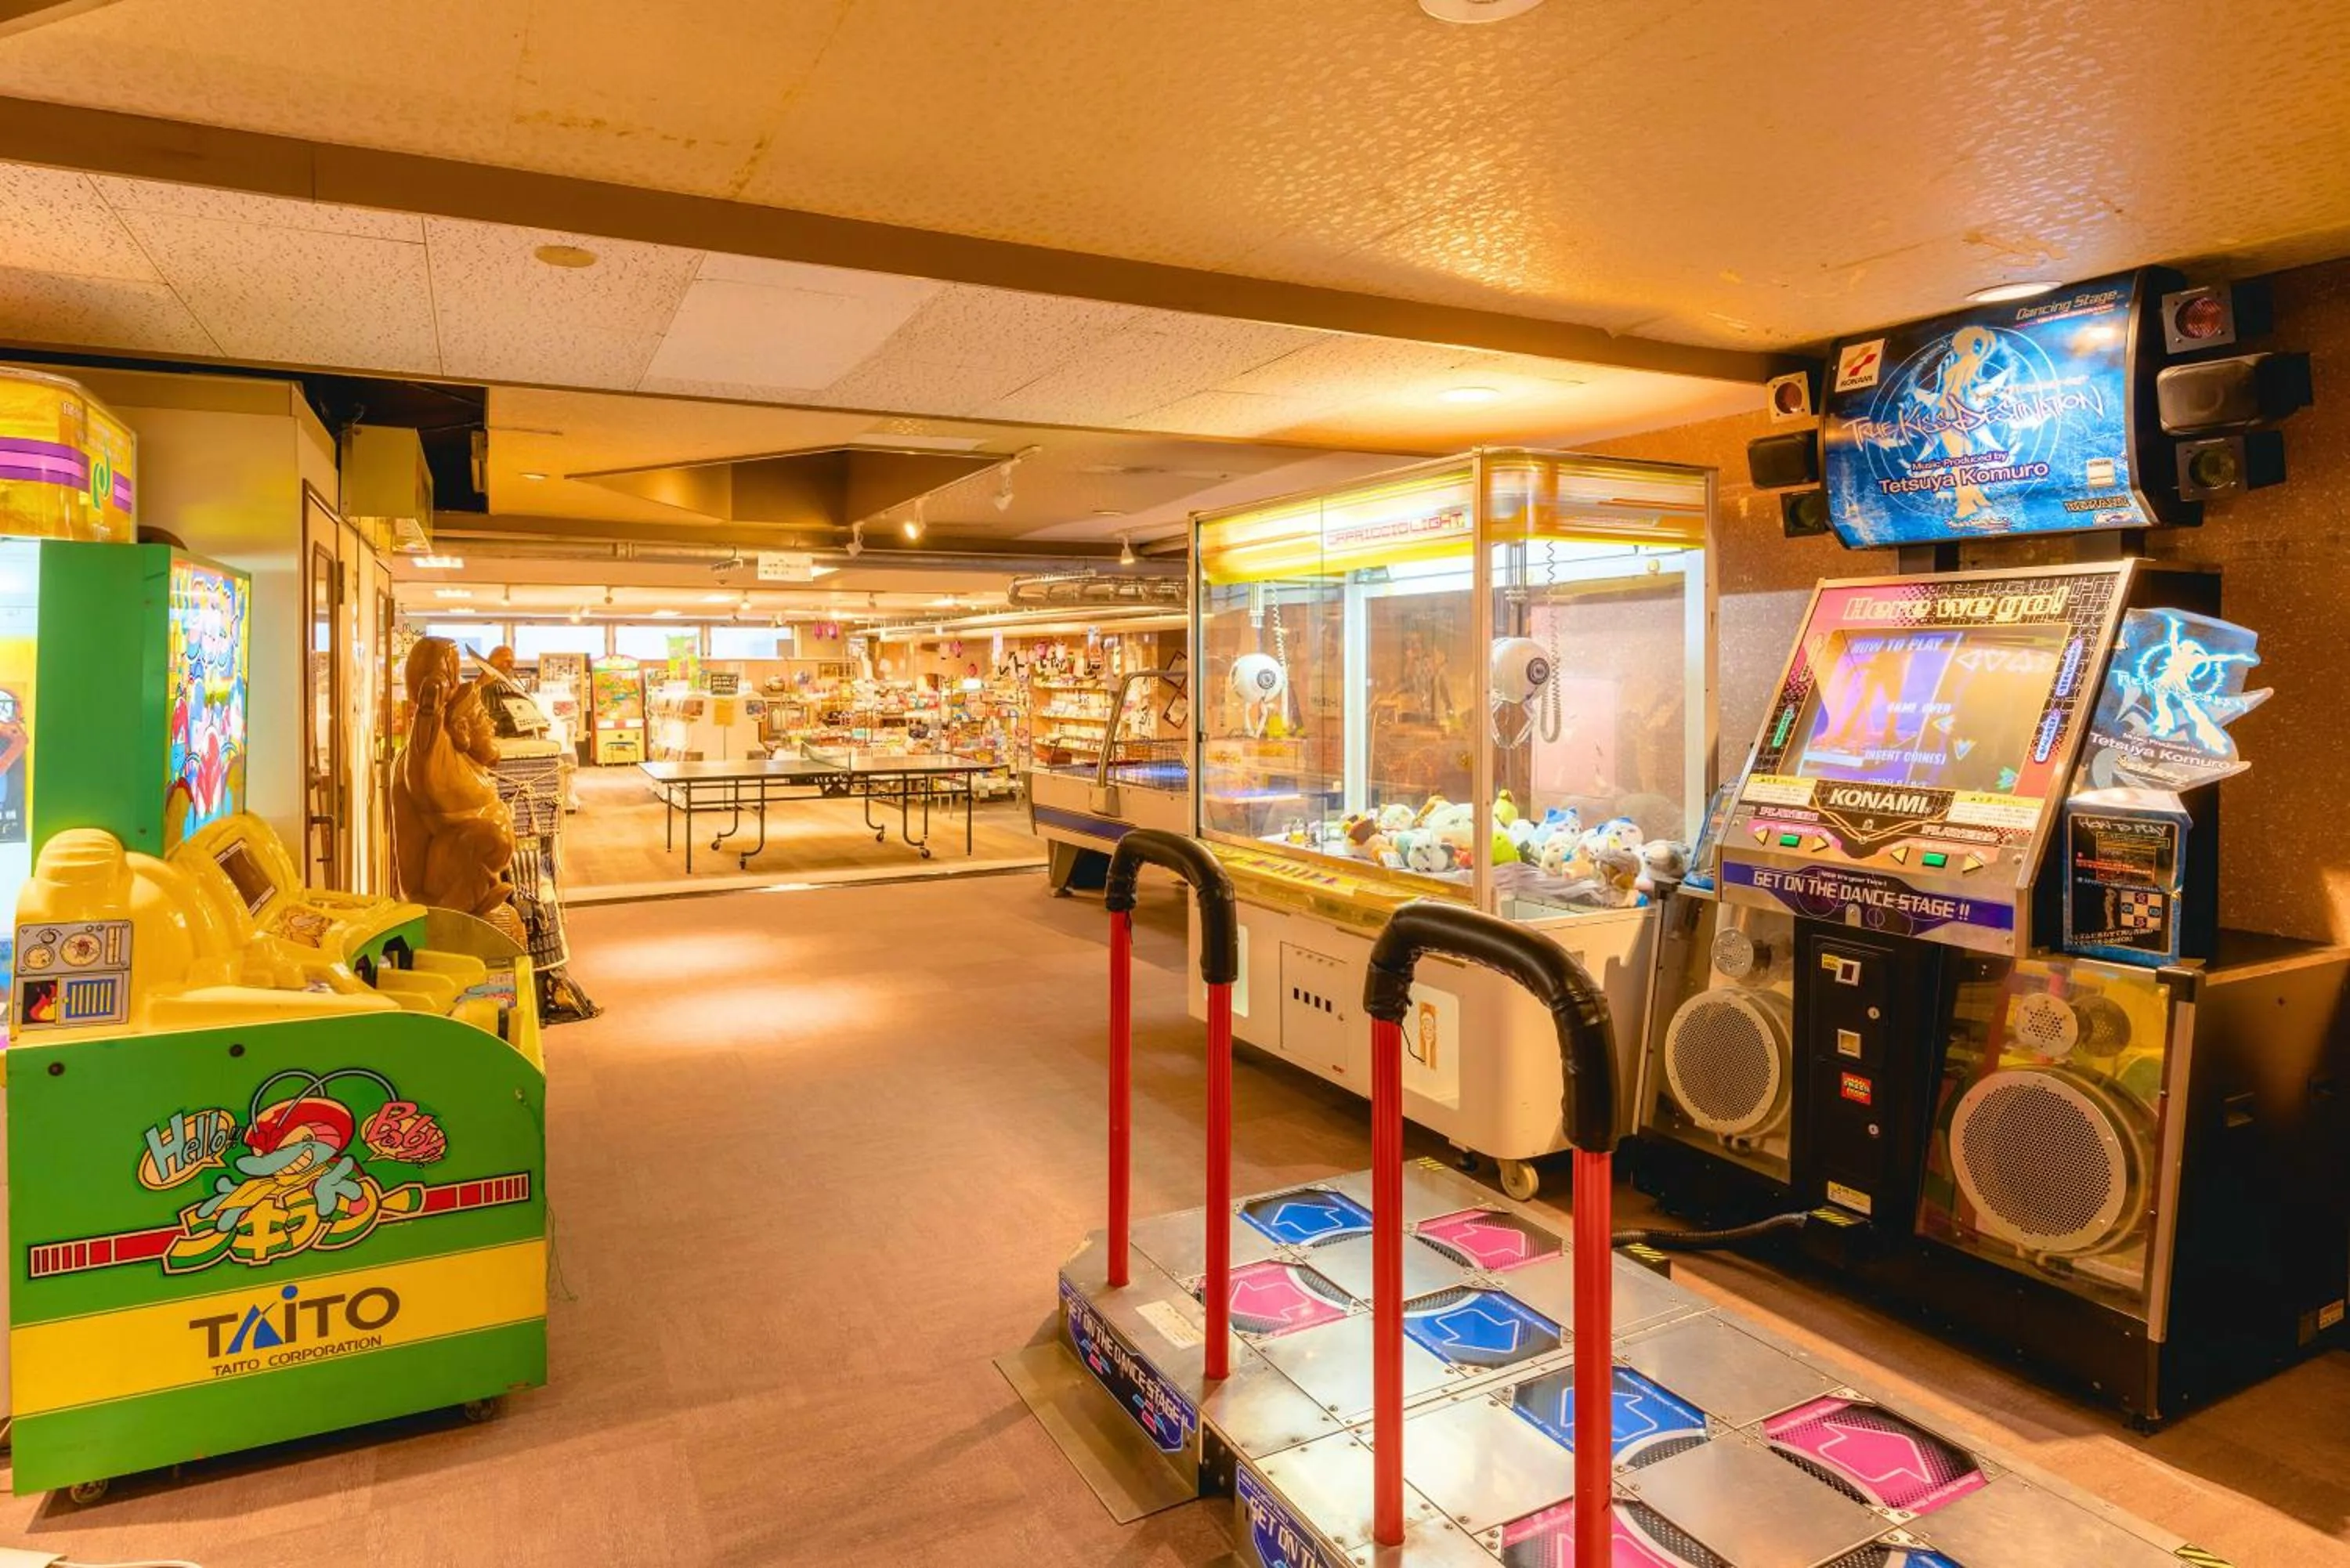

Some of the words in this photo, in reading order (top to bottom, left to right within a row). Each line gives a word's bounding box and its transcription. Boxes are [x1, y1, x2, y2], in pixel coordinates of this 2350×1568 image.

[2016, 299, 2072, 320] Dancing
[2074, 290, 2118, 306] Stage
[1841, 374, 1873, 387] KONAMI
[1943, 453, 1992, 468] Produced
[1994, 450, 2008, 462] by
[1879, 475, 1956, 494] Tetsuya
[1960, 462, 2049, 486] Komuro
[1842, 596, 1932, 620] Here
[1936, 596, 1995, 618] we
[1995, 586, 2070, 622] go!
[1851, 638, 1882, 654] HOW
[1885, 638, 1904, 653] TO
[1907, 636, 1946, 652] PLAY
[2090, 732, 2154, 757] Tetsuya
[2159, 750, 2231, 769] Komuro
[1829, 788, 1929, 814] KONAMI
[1753, 869, 1782, 887] GET
[1784, 875, 1804, 892] ON
[1808, 880, 1837, 898] THE
[1840, 884, 1896, 909] DANCE
[1896, 894, 1956, 919] STAGE
[1958, 903, 1970, 921] !!
[212, 1358, 260, 1376] TAITO
[268, 1334, 382, 1367] CORPORATION
[1096, 1326, 1114, 1360] THE
[1113, 1346, 1147, 1393] DANCE
[1146, 1379, 1180, 1426] STAGE
[1249, 1495, 1277, 1537] GET
[1278, 1525, 1298, 1561] ON
